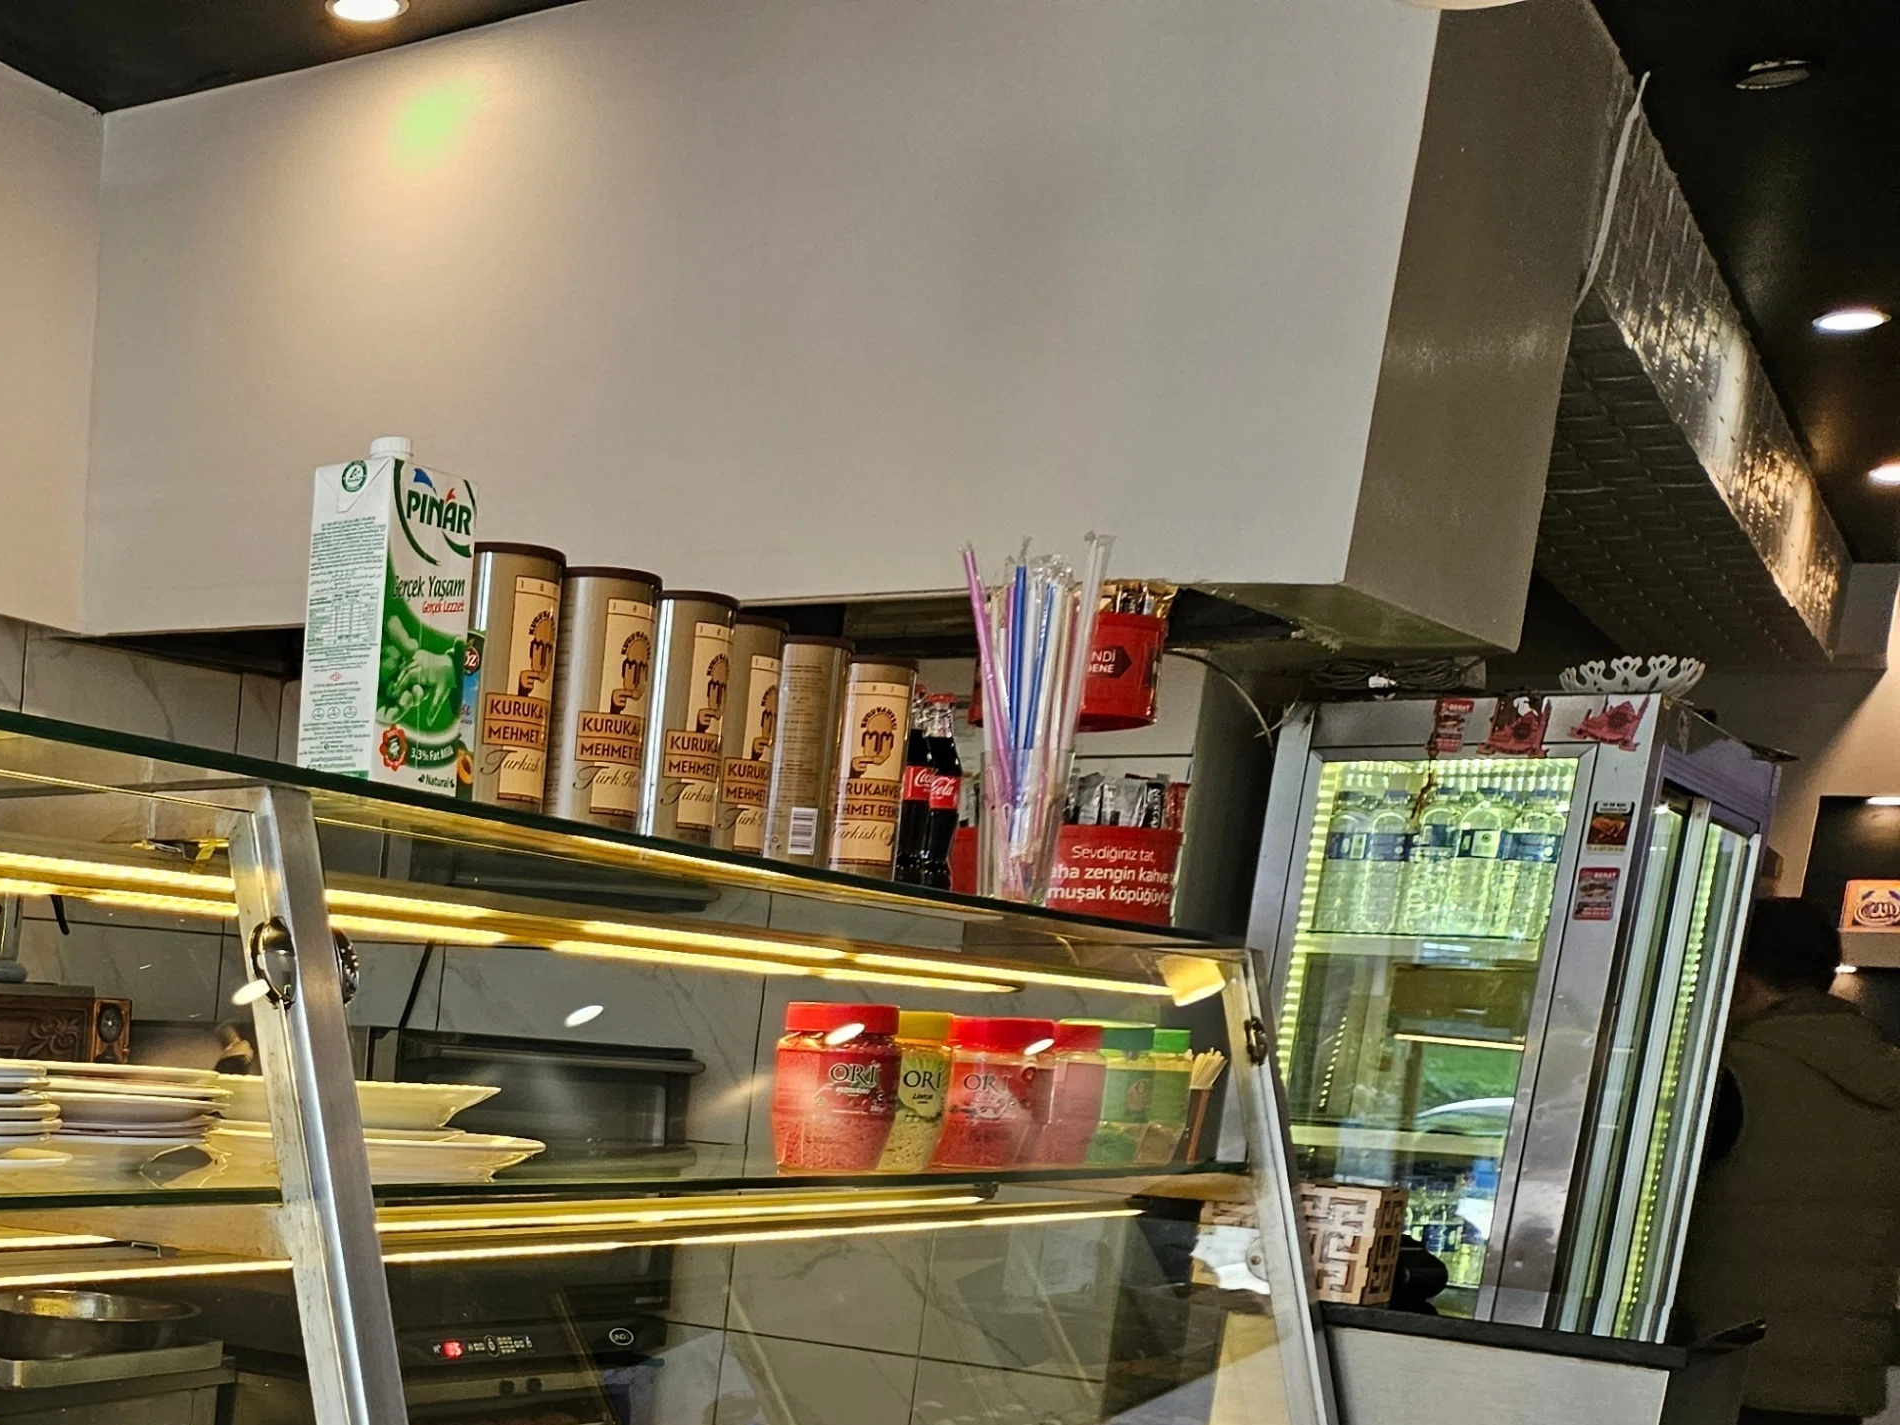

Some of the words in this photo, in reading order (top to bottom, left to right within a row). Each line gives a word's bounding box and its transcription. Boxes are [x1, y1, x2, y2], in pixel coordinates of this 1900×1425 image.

[406, 490, 472, 536] PINAR
[392, 575, 425, 602] Gerçek
[428, 575, 465, 602] Yaşam
[487, 725, 540, 743] MEHMET
[579, 741, 634, 760] MEHMET
[667, 759, 715, 777] MEHMET
[659, 781, 714, 806] Turkis
[1071, 845, 1136, 863] Sevdiğiniz
[1051, 863, 1080, 879] aha
[1084, 866, 1136, 883] zengin
[1047, 883, 1106, 903] muşak
